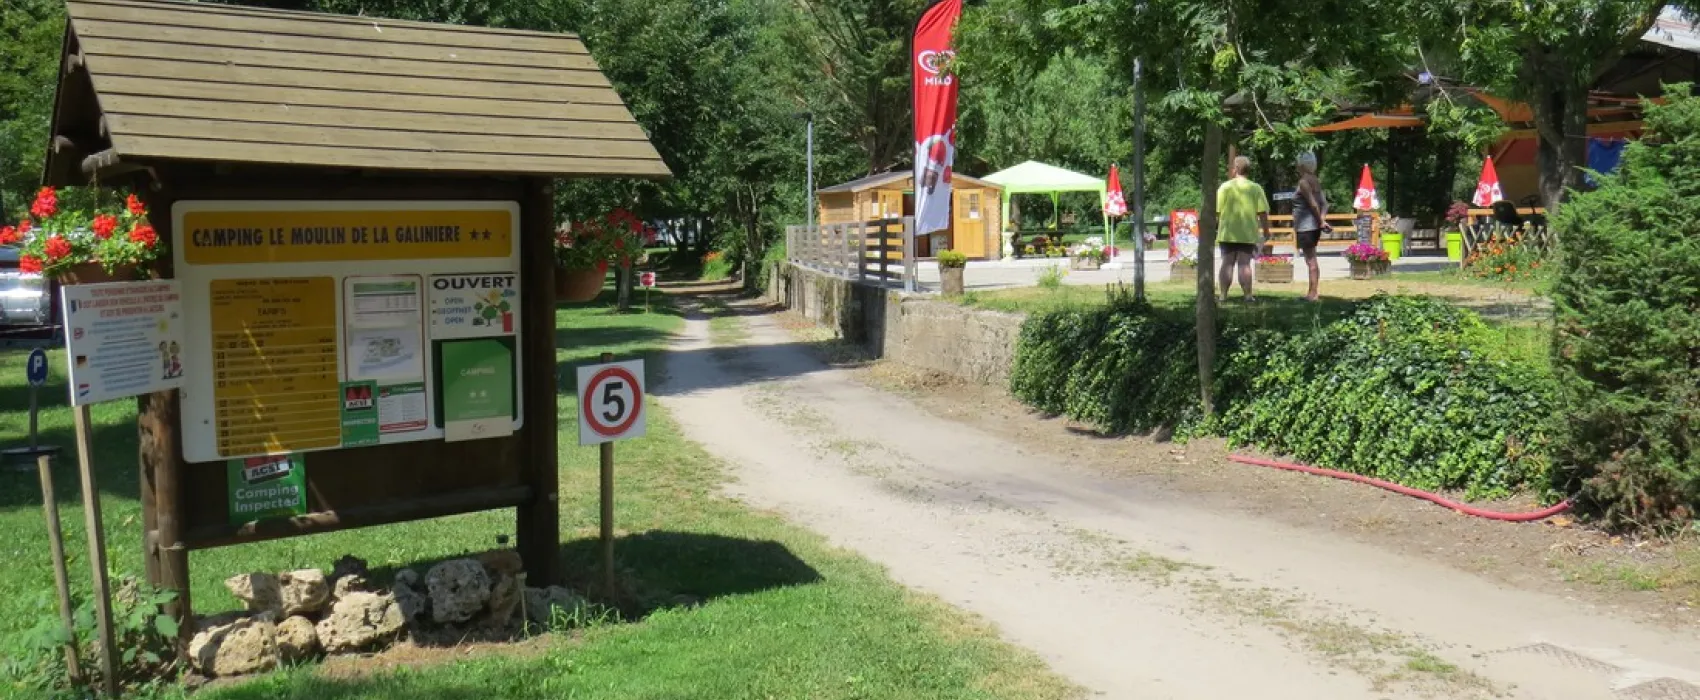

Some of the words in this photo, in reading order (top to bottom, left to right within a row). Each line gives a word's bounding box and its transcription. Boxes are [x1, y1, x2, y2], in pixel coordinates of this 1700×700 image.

[192, 228, 264, 247] CAMPING
[269, 228, 286, 245] LE
[291, 227, 347, 245] MOULIN
[351, 226, 368, 244] DE
[373, 226, 389, 244] LA
[395, 225, 461, 244] GALINIERE
[433, 276, 515, 290] OUVERT
[444, 297, 465, 306] OPEN
[444, 316, 465, 326] OPEN
[33, 355, 43, 374] P
[602, 381, 625, 423] 5
[235, 483, 299, 499] Camping
[234, 495, 300, 512] Inspected
